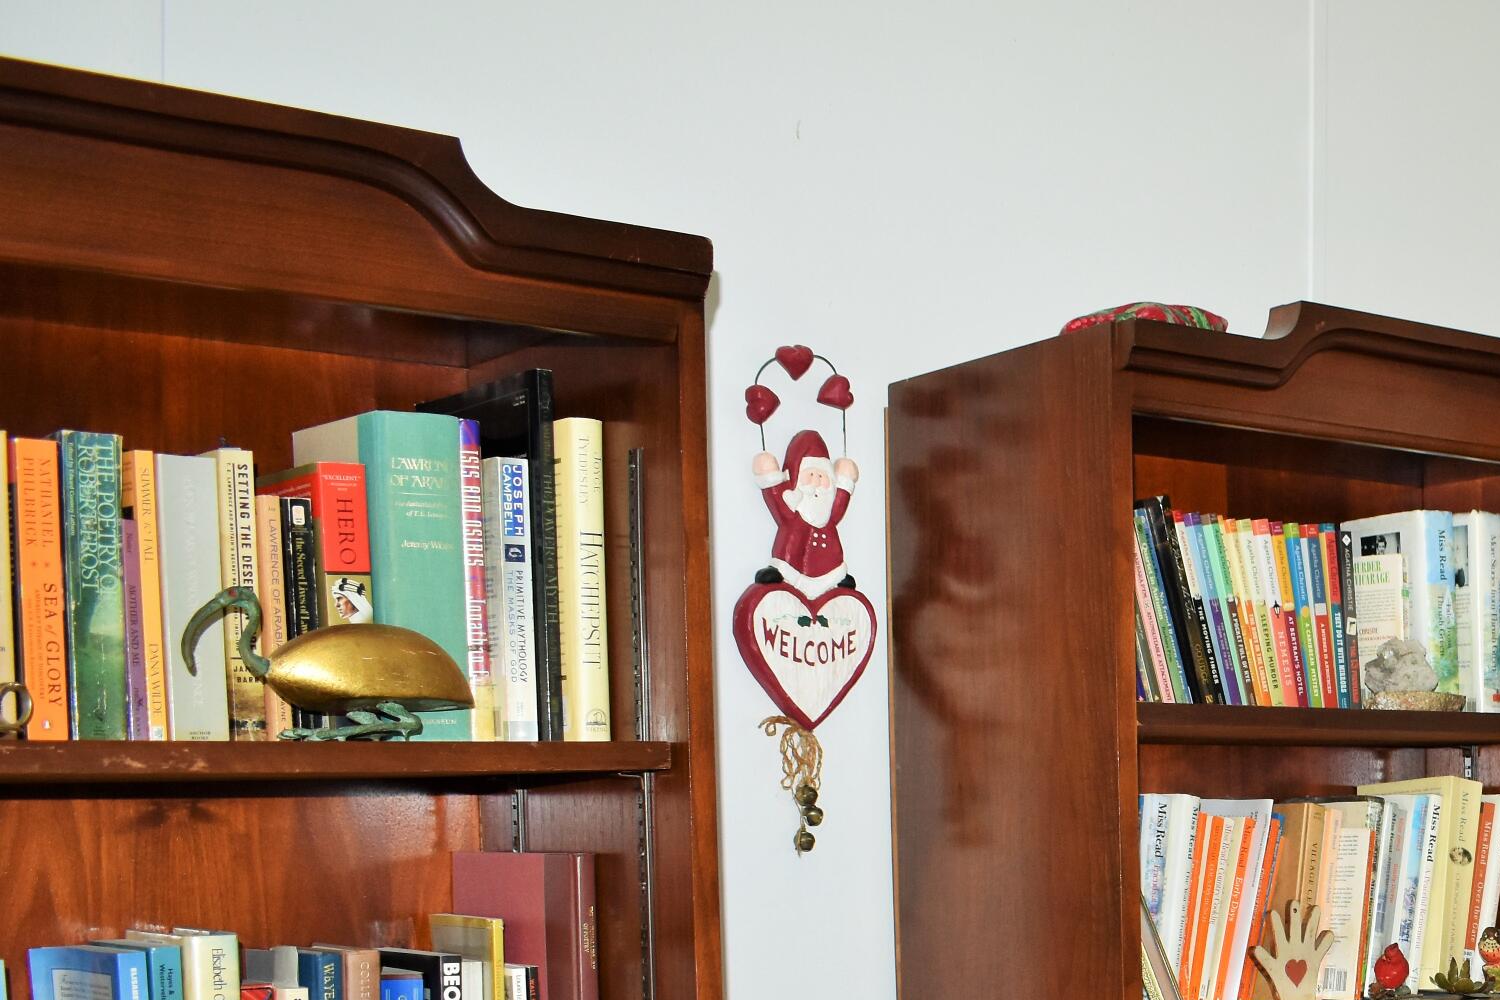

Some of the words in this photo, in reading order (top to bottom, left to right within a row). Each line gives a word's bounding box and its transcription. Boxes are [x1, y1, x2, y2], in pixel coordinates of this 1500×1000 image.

[96, 440, 114, 483] THE
[78, 444, 98, 520] ROBERT
[141, 467, 151, 516] SUMMER
[238, 464, 250, 519] SETTING
[502, 465, 514, 536] CAMPBELL
[512, 465, 525, 536] JOSEPH
[23, 457, 38, 546] PHILBRICK
[40, 459, 54, 548] NATHANIEL
[98, 492, 117, 573] POETRY
[241, 525, 252, 549] THE
[335, 497, 358, 565] HERO
[1438, 529, 1447, 551] Miss
[81, 529, 101, 589] FROST
[143, 538, 154, 562] FALL
[269, 520, 281, 584] LAWRENCE
[1440, 555, 1448, 581] Read
[273, 589, 281, 608] OF
[505, 570, 516, 593] THE
[515, 570, 526, 620] PRIMITIVE
[579, 530, 603, 669] HATCHEPSUT
[43, 583, 58, 619] SEA
[128, 585, 138, 622] MOTHER
[507, 597, 517, 635] MASKS
[129, 624, 139, 650] AND
[274, 610, 285, 648] ARABIA
[509, 640, 517, 653] OF
[762, 617, 857, 666] WELCOME
[131, 652, 140, 666] ME
[148, 643, 160, 677] DANA
[516, 624, 529, 683] MYTHOLOGY
[1195, 644, 1209, 686] GOUDGE
[1199, 622, 1212, 655] MOVING
[1207, 657, 1220, 685] FINGER
[1260, 614, 1272, 654] SLEEPING
[1269, 656, 1279, 689] MURDER
[1278, 631, 1293, 687] NEMESIS
[45, 640, 63, 708] GLORY
[510, 661, 519, 683] GOD
[151, 680, 164, 715] WILDE
[1158, 802, 1168, 827] Miss
[1189, 806, 1198, 831] Miss
[1431, 804, 1441, 832] Miss
[1459, 791, 1470, 817] Miss
[1154, 829, 1166, 859] Read
[1187, 834, 1195, 860] Read
[1426, 833, 1438, 863] Read
[1458, 818, 1468, 843] Read
[1484, 820, 1493, 841] Miss
[1308, 842, 1319, 885] VILLAGE
[1480, 843, 1490, 866] Read
[1233, 876, 1244, 899] Early
[1475, 880, 1485, 903] Over
[1227, 900, 1240, 923] Days
[159, 963, 168, 1000] Westervelt
[211, 948, 227, 991] Elisabeth
